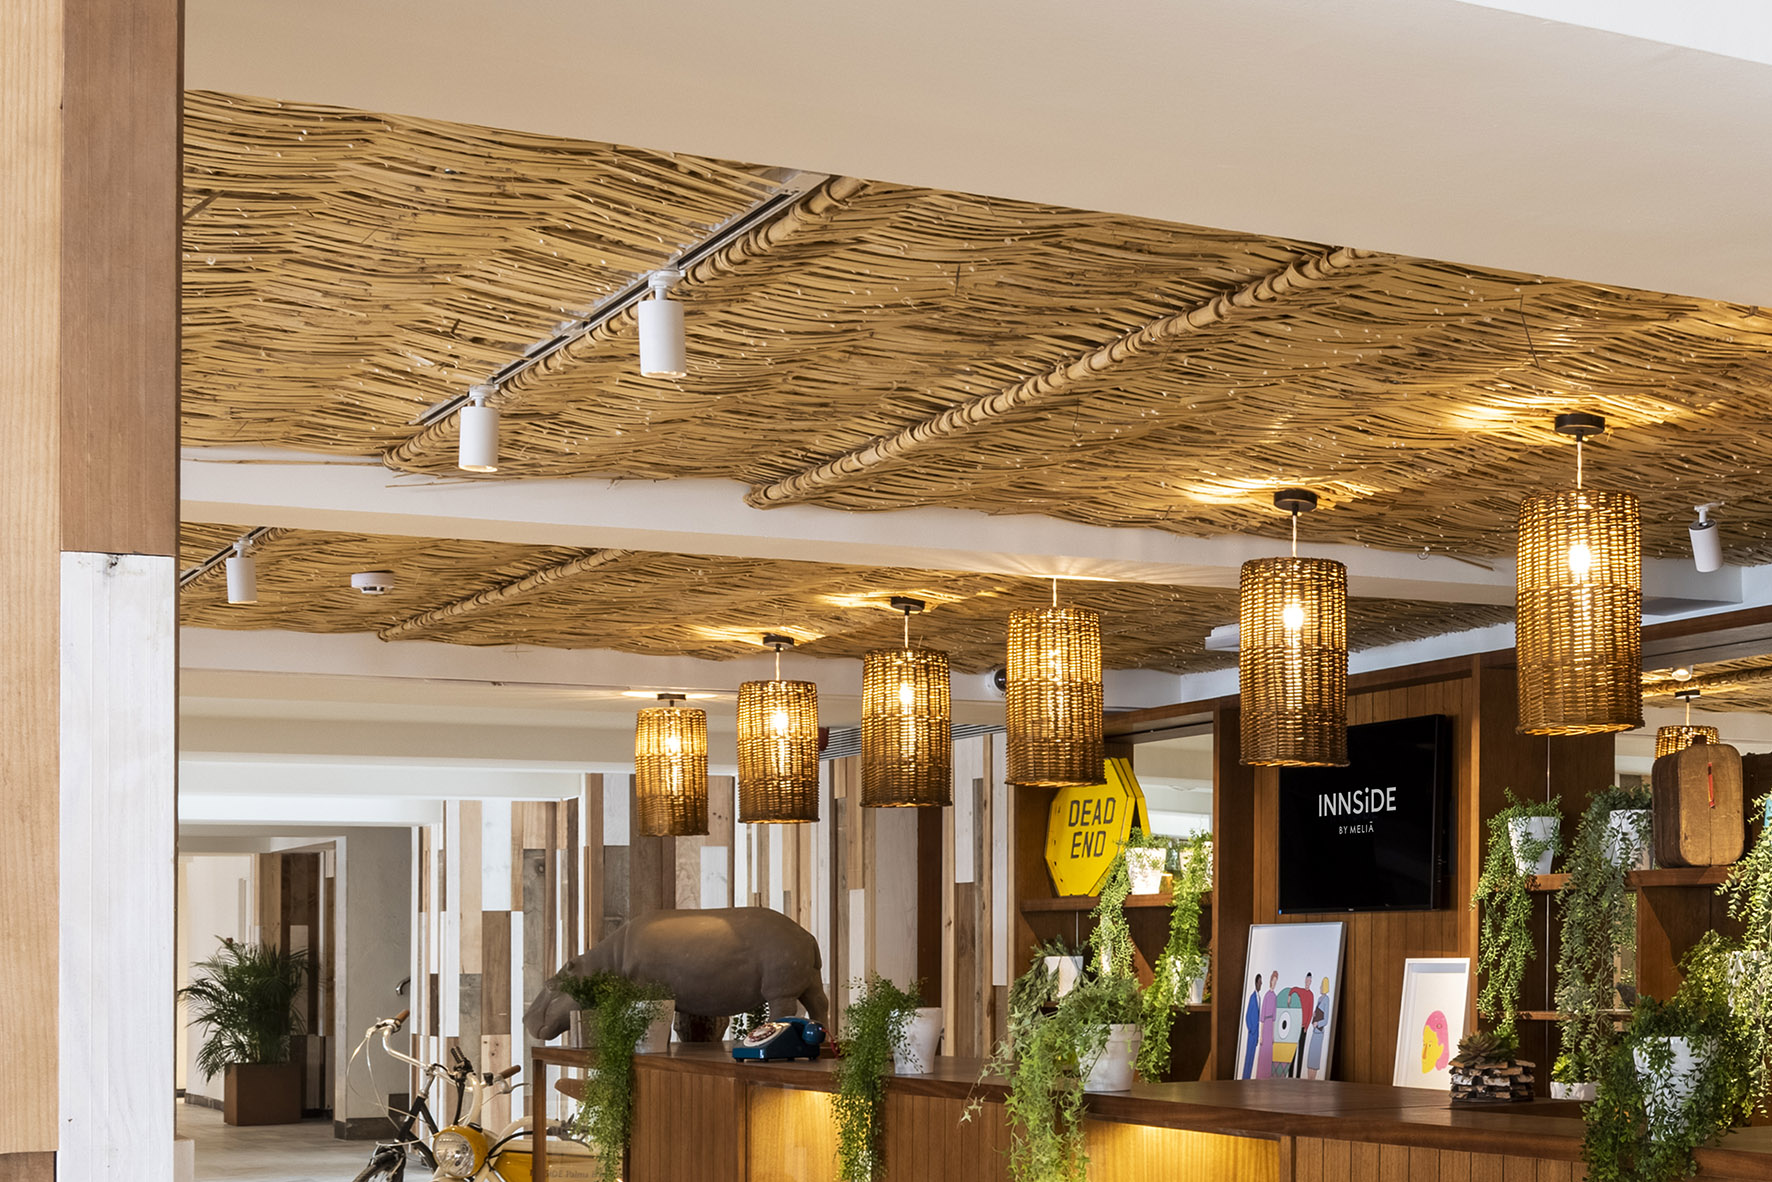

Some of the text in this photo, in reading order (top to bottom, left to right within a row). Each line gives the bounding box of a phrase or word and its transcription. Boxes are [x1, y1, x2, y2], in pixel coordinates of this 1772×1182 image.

[1068, 797, 1116, 828] DEAD
[1338, 826, 1349, 835] BY
[1071, 831, 1106, 858] END
